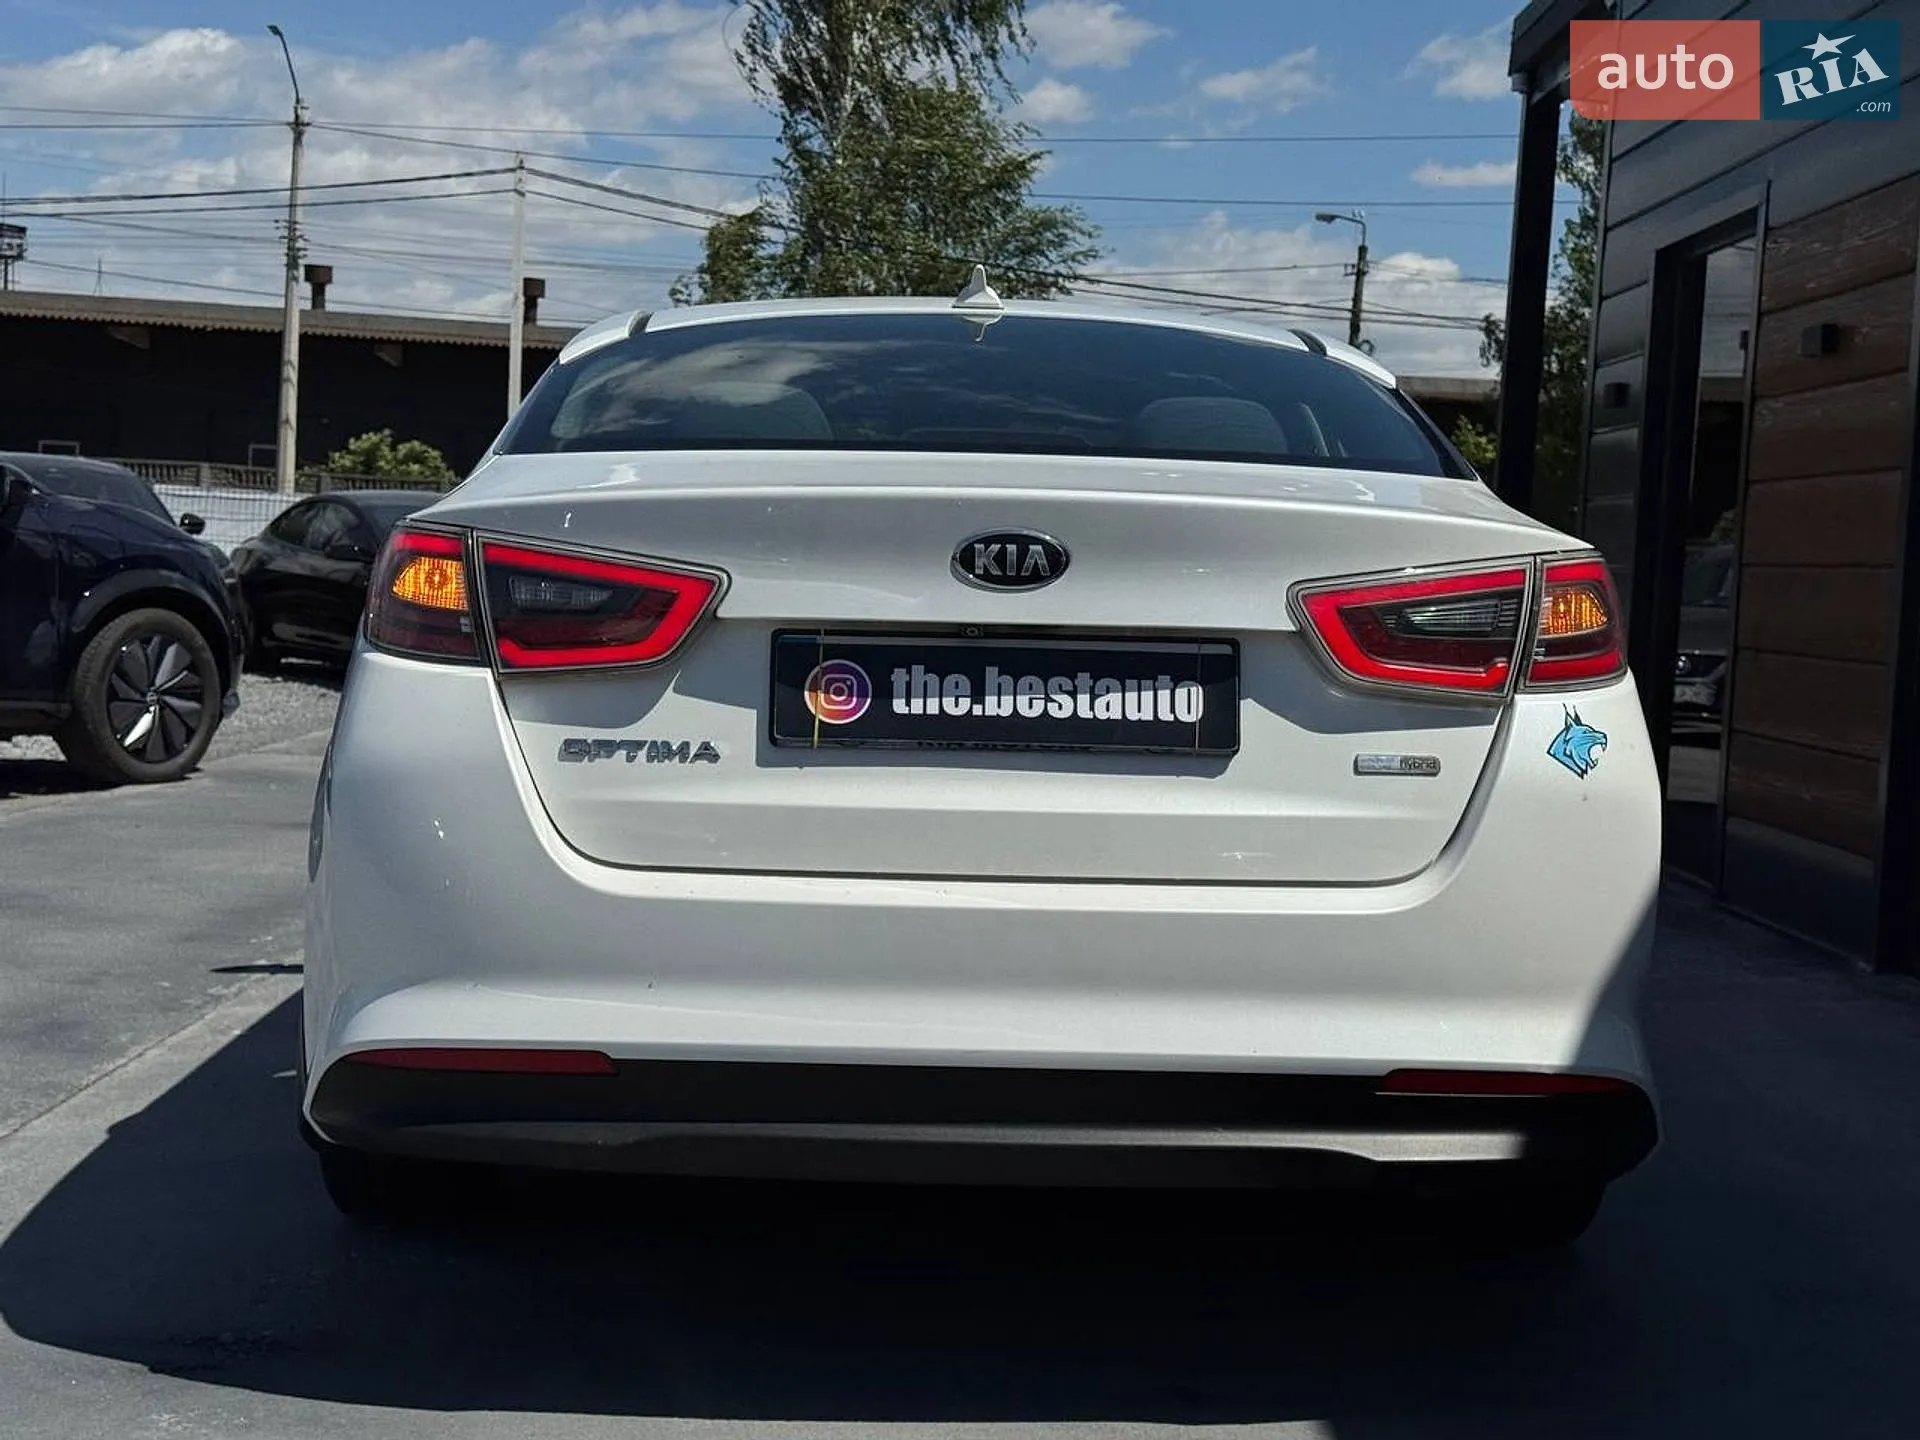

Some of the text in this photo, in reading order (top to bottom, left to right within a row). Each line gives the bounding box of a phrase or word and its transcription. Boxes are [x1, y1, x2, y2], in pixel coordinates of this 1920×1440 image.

[974, 543, 1050, 576] KIA
[890, 664, 1204, 722] the.bestauto
[558, 738, 721, 764] OPTIMA
